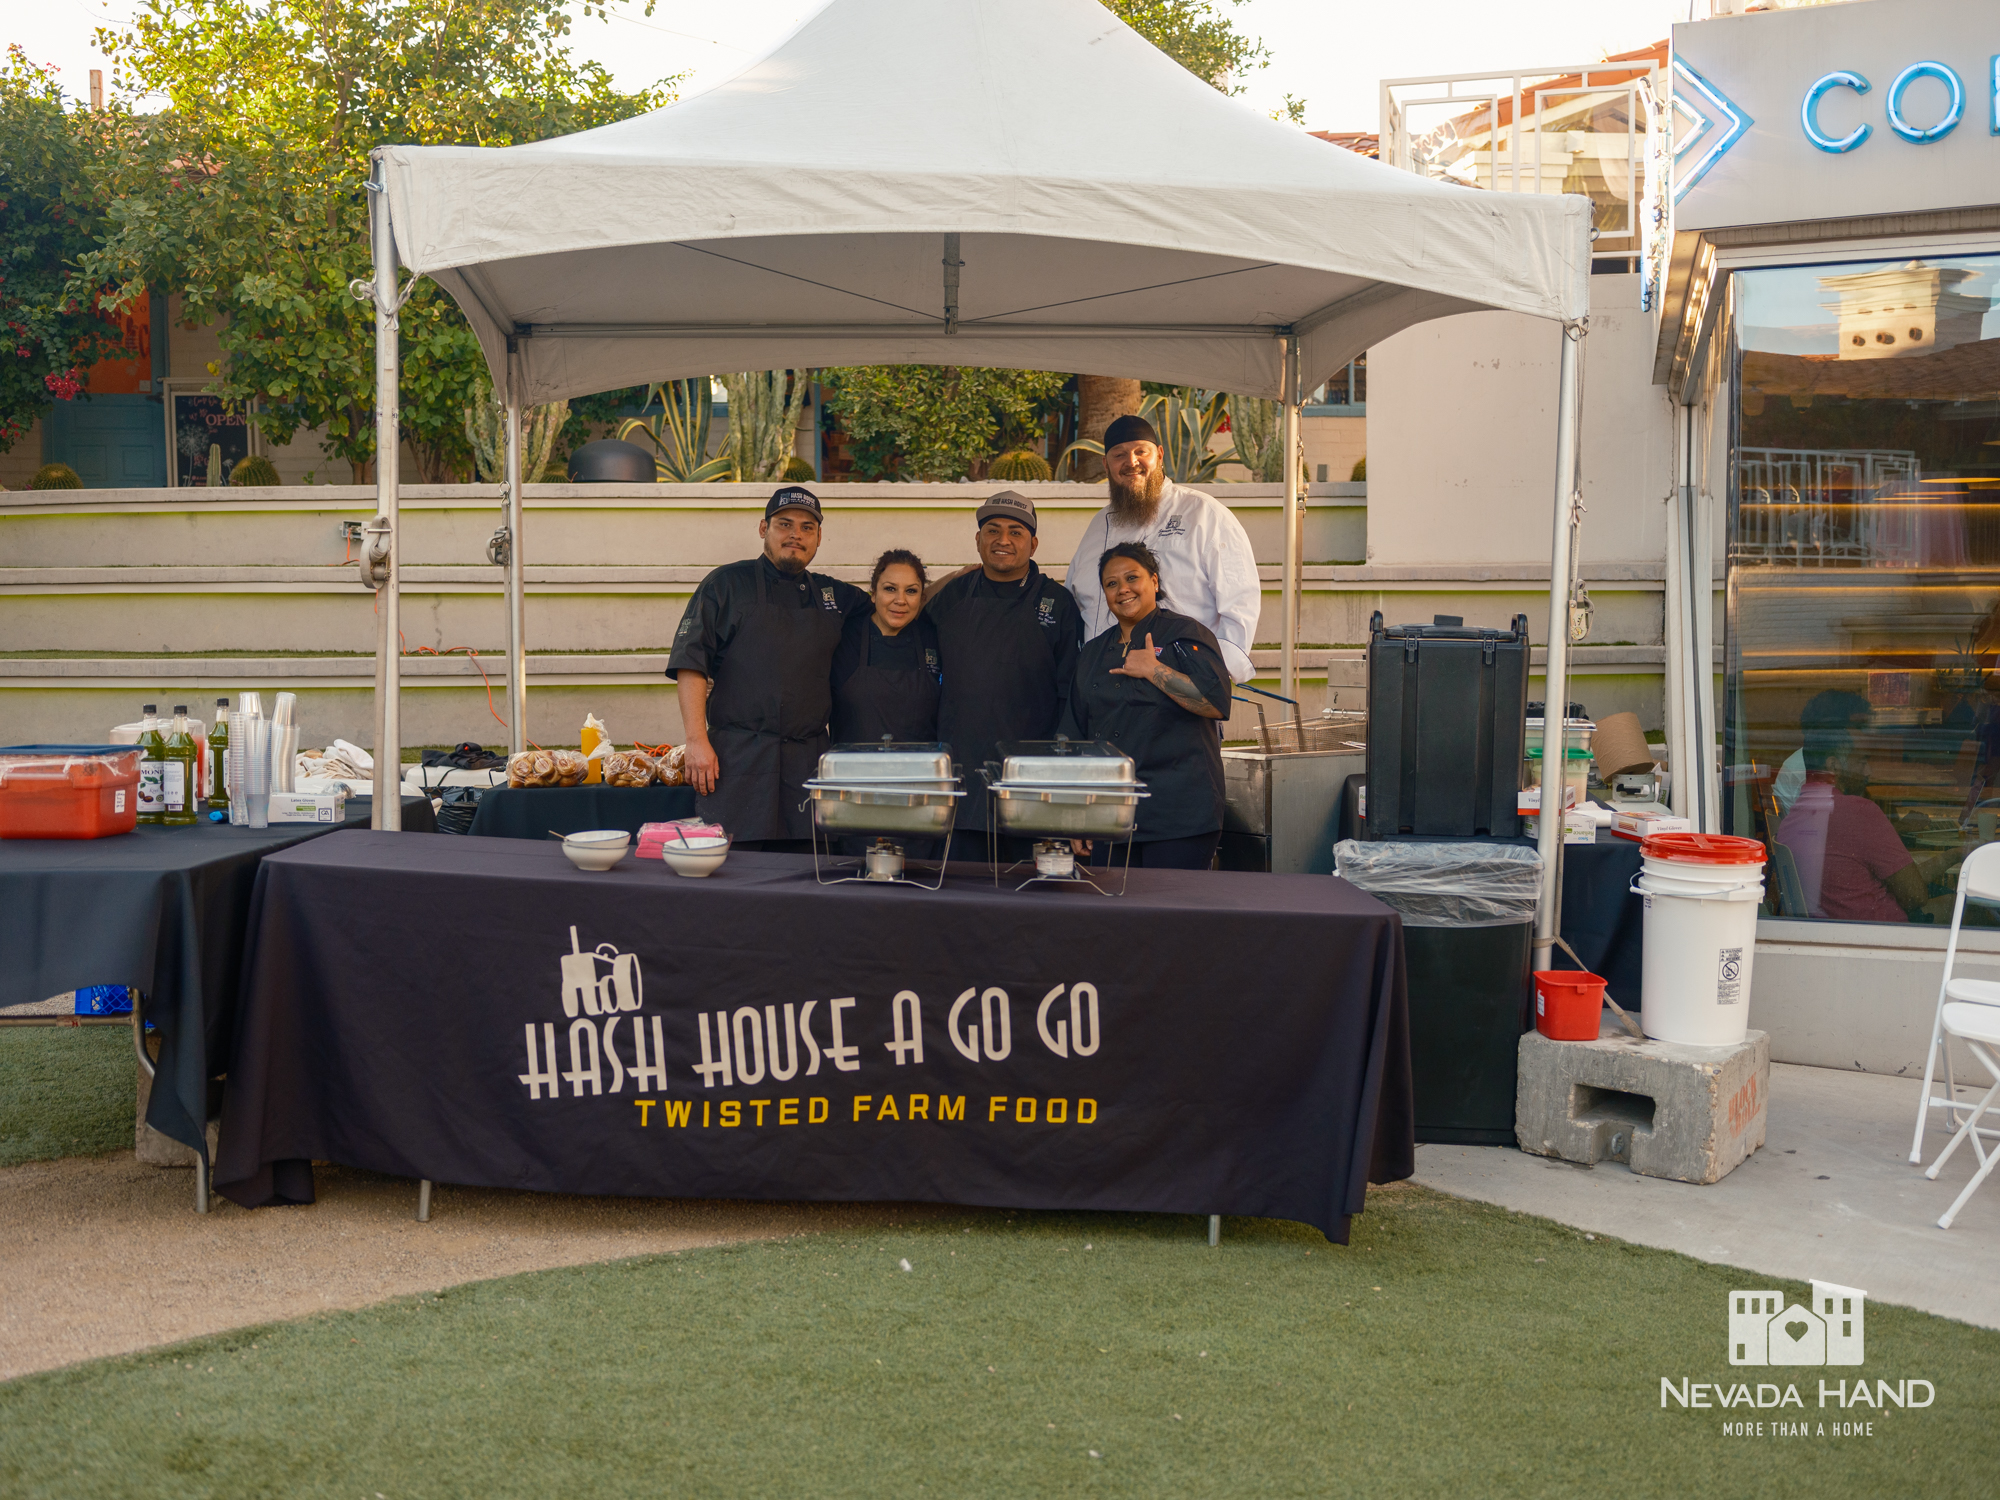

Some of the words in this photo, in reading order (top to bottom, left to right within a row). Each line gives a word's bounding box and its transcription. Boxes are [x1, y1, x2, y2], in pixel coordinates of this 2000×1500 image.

[1801, 54, 2000, 154] CO
[205, 413, 247, 426] OPEN
[518, 1015, 667, 1099] HASH
[692, 998, 860, 1088] HOUSE
[885, 990, 923, 1065] A
[948, 987, 1011, 1063] GO
[1037, 982, 1100, 1059] GO
[635, 1096, 829, 1128] TWISTED
[853, 1094, 966, 1122] FARM
[989, 1096, 1098, 1124] FOOD
